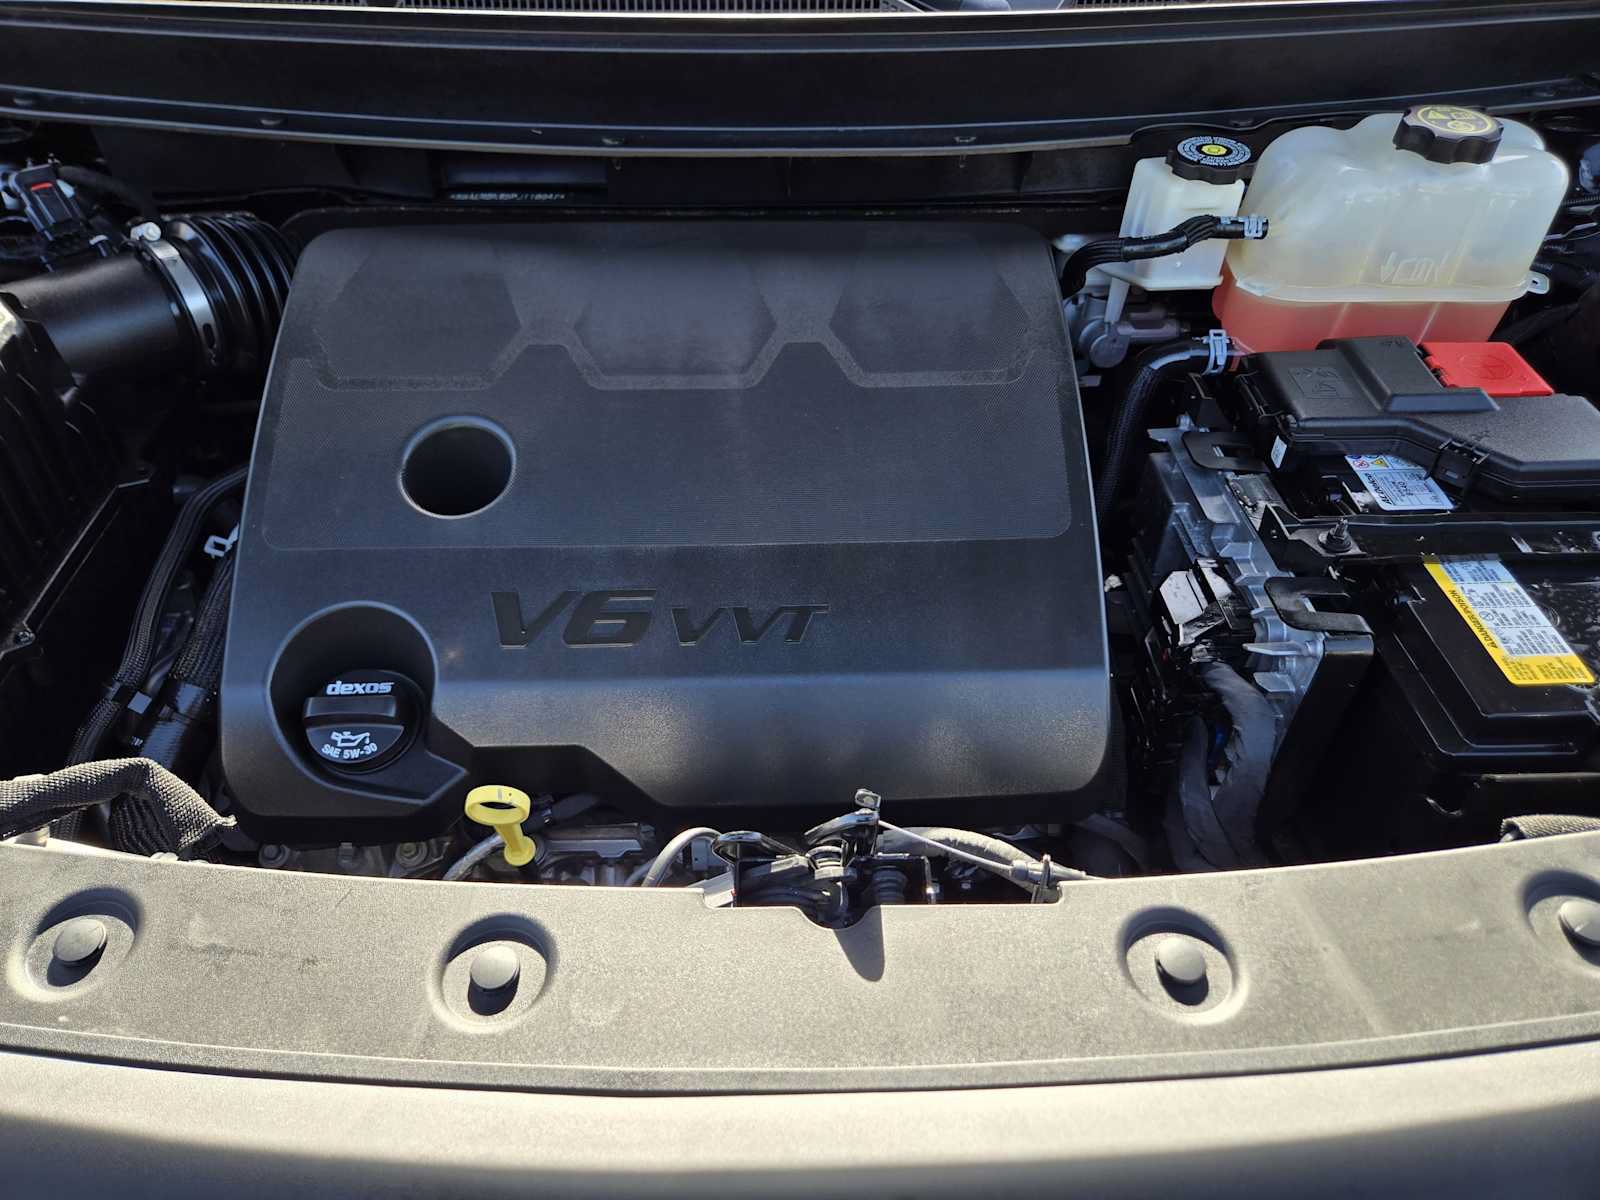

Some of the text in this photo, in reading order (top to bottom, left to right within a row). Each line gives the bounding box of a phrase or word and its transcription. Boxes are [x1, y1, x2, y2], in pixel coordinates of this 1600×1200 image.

[491, 588, 832, 649] V6 VVT
[325, 680, 395, 695] dexos
[321, 742, 378, 760] SAE 5W-30
